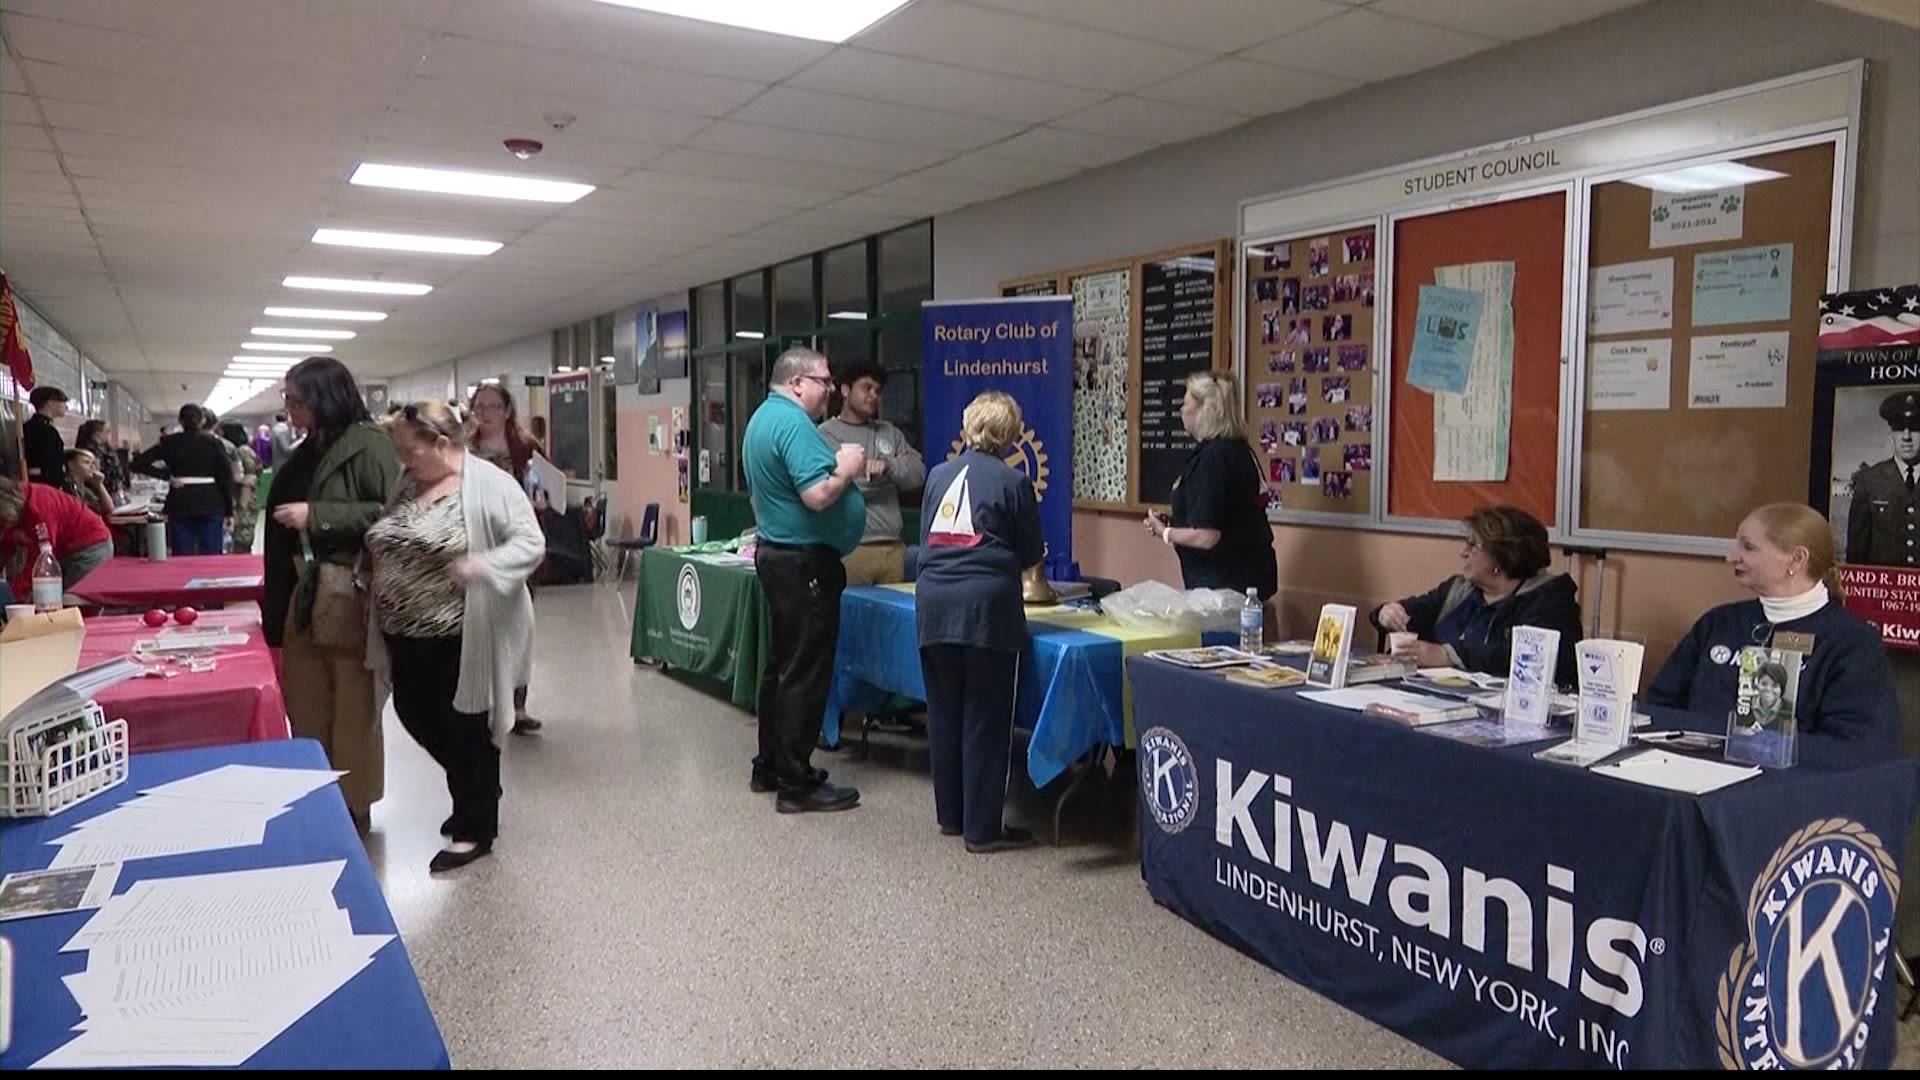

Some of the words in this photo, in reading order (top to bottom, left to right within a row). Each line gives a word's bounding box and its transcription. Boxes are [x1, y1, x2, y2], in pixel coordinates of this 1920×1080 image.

[1403, 167, 1478, 196] STUDENT
[1481, 149, 1561, 180] COUNCIL
[934, 324, 991, 344] Rotary
[995, 322, 1036, 339] Club
[1040, 321, 1059, 338] of
[944, 358, 1049, 376] Lindenhurst
[1845, 351, 1889, 364] TOWN
[1870, 364, 1920, 380] HON
[1880, 573, 1893, 586] R.
[1845, 586, 1889, 599] UNITED
[1144, 735, 1188, 766] KIWANIS
[1761, 845, 1879, 926] KIWANIS
[1215, 857, 1384, 963] LINDENHURST,
[1392, 935, 1463, 991] NEW
[1468, 968, 1566, 1047] YORK,
[1784, 883, 1858, 1067] K
